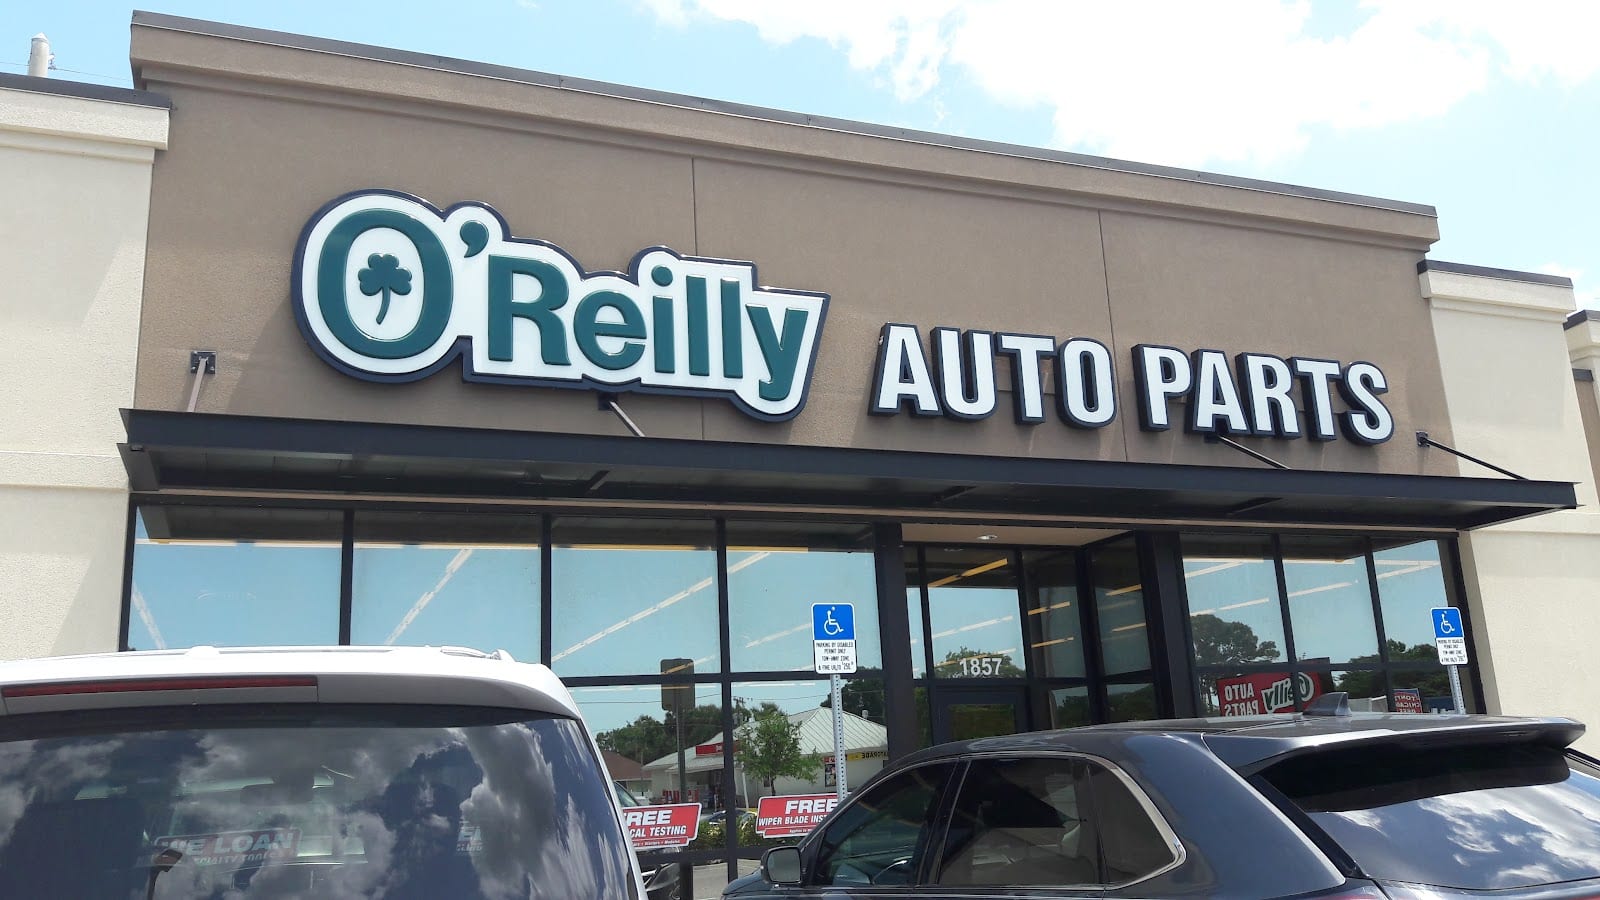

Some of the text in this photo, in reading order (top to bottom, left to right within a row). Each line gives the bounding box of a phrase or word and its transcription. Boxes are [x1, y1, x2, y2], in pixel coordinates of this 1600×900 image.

[316, 206, 1394, 442] O'Reilly AUTO PARTS
[959, 657, 1002, 676] 1857
[785, 798, 838, 815] FREE
[624, 809, 673, 827] REE
[758, 816, 782, 826] WIPER
[784, 815, 809, 825] BLADE
[629, 825, 687, 838] CAL TESTING
[213, 831, 294, 855] LOAN
